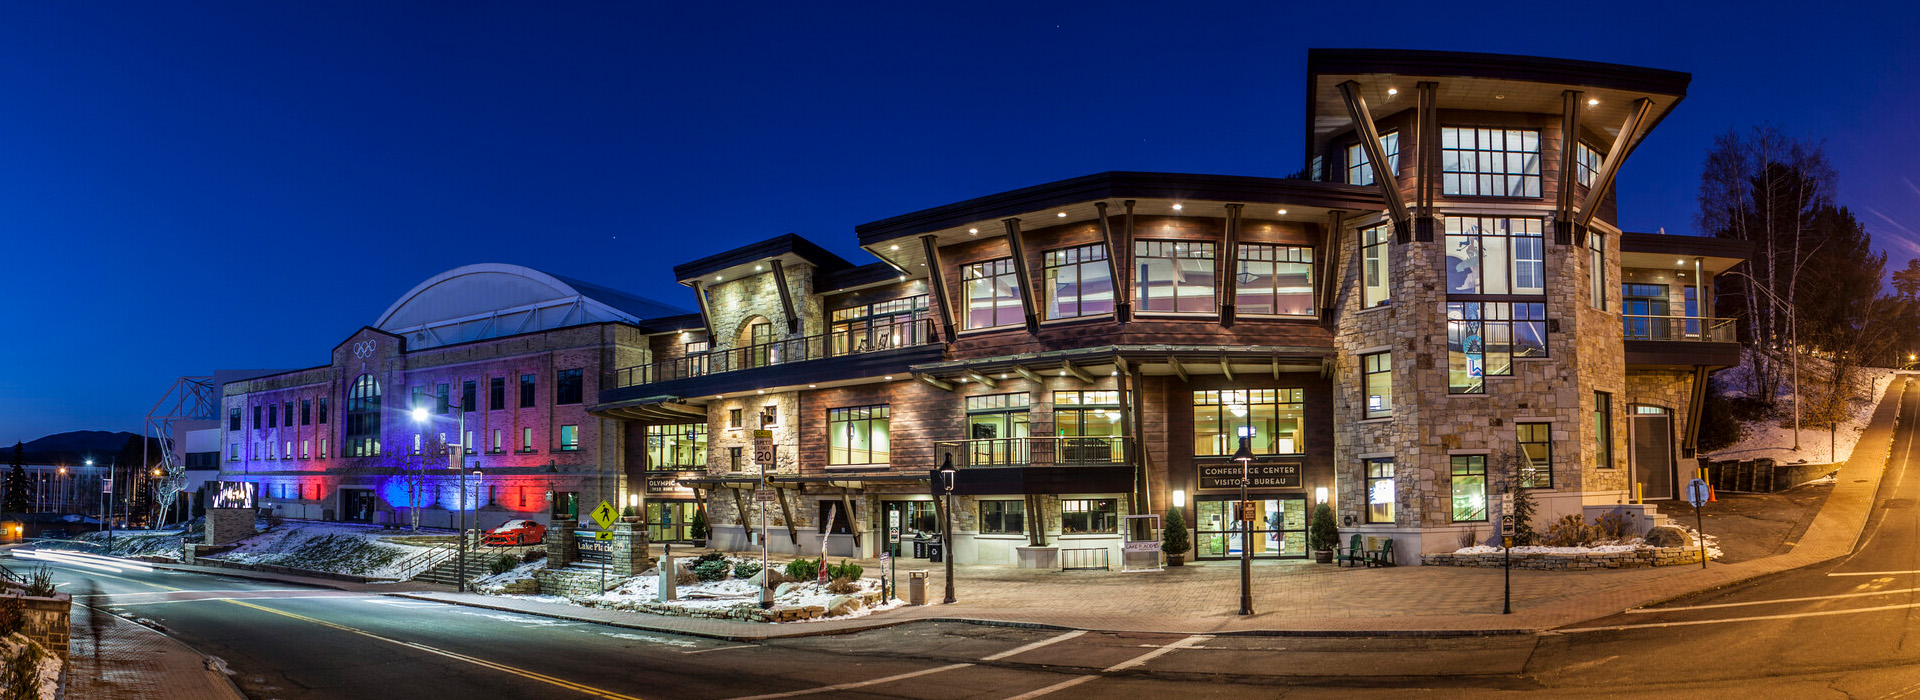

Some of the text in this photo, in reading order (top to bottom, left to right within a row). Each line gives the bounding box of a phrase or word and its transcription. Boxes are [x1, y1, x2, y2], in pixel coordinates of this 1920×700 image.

[757, 451, 771, 461] 20
[1205, 466, 1295, 475] CONFERECE CENTER
[578, 542, 593, 550] Lake
